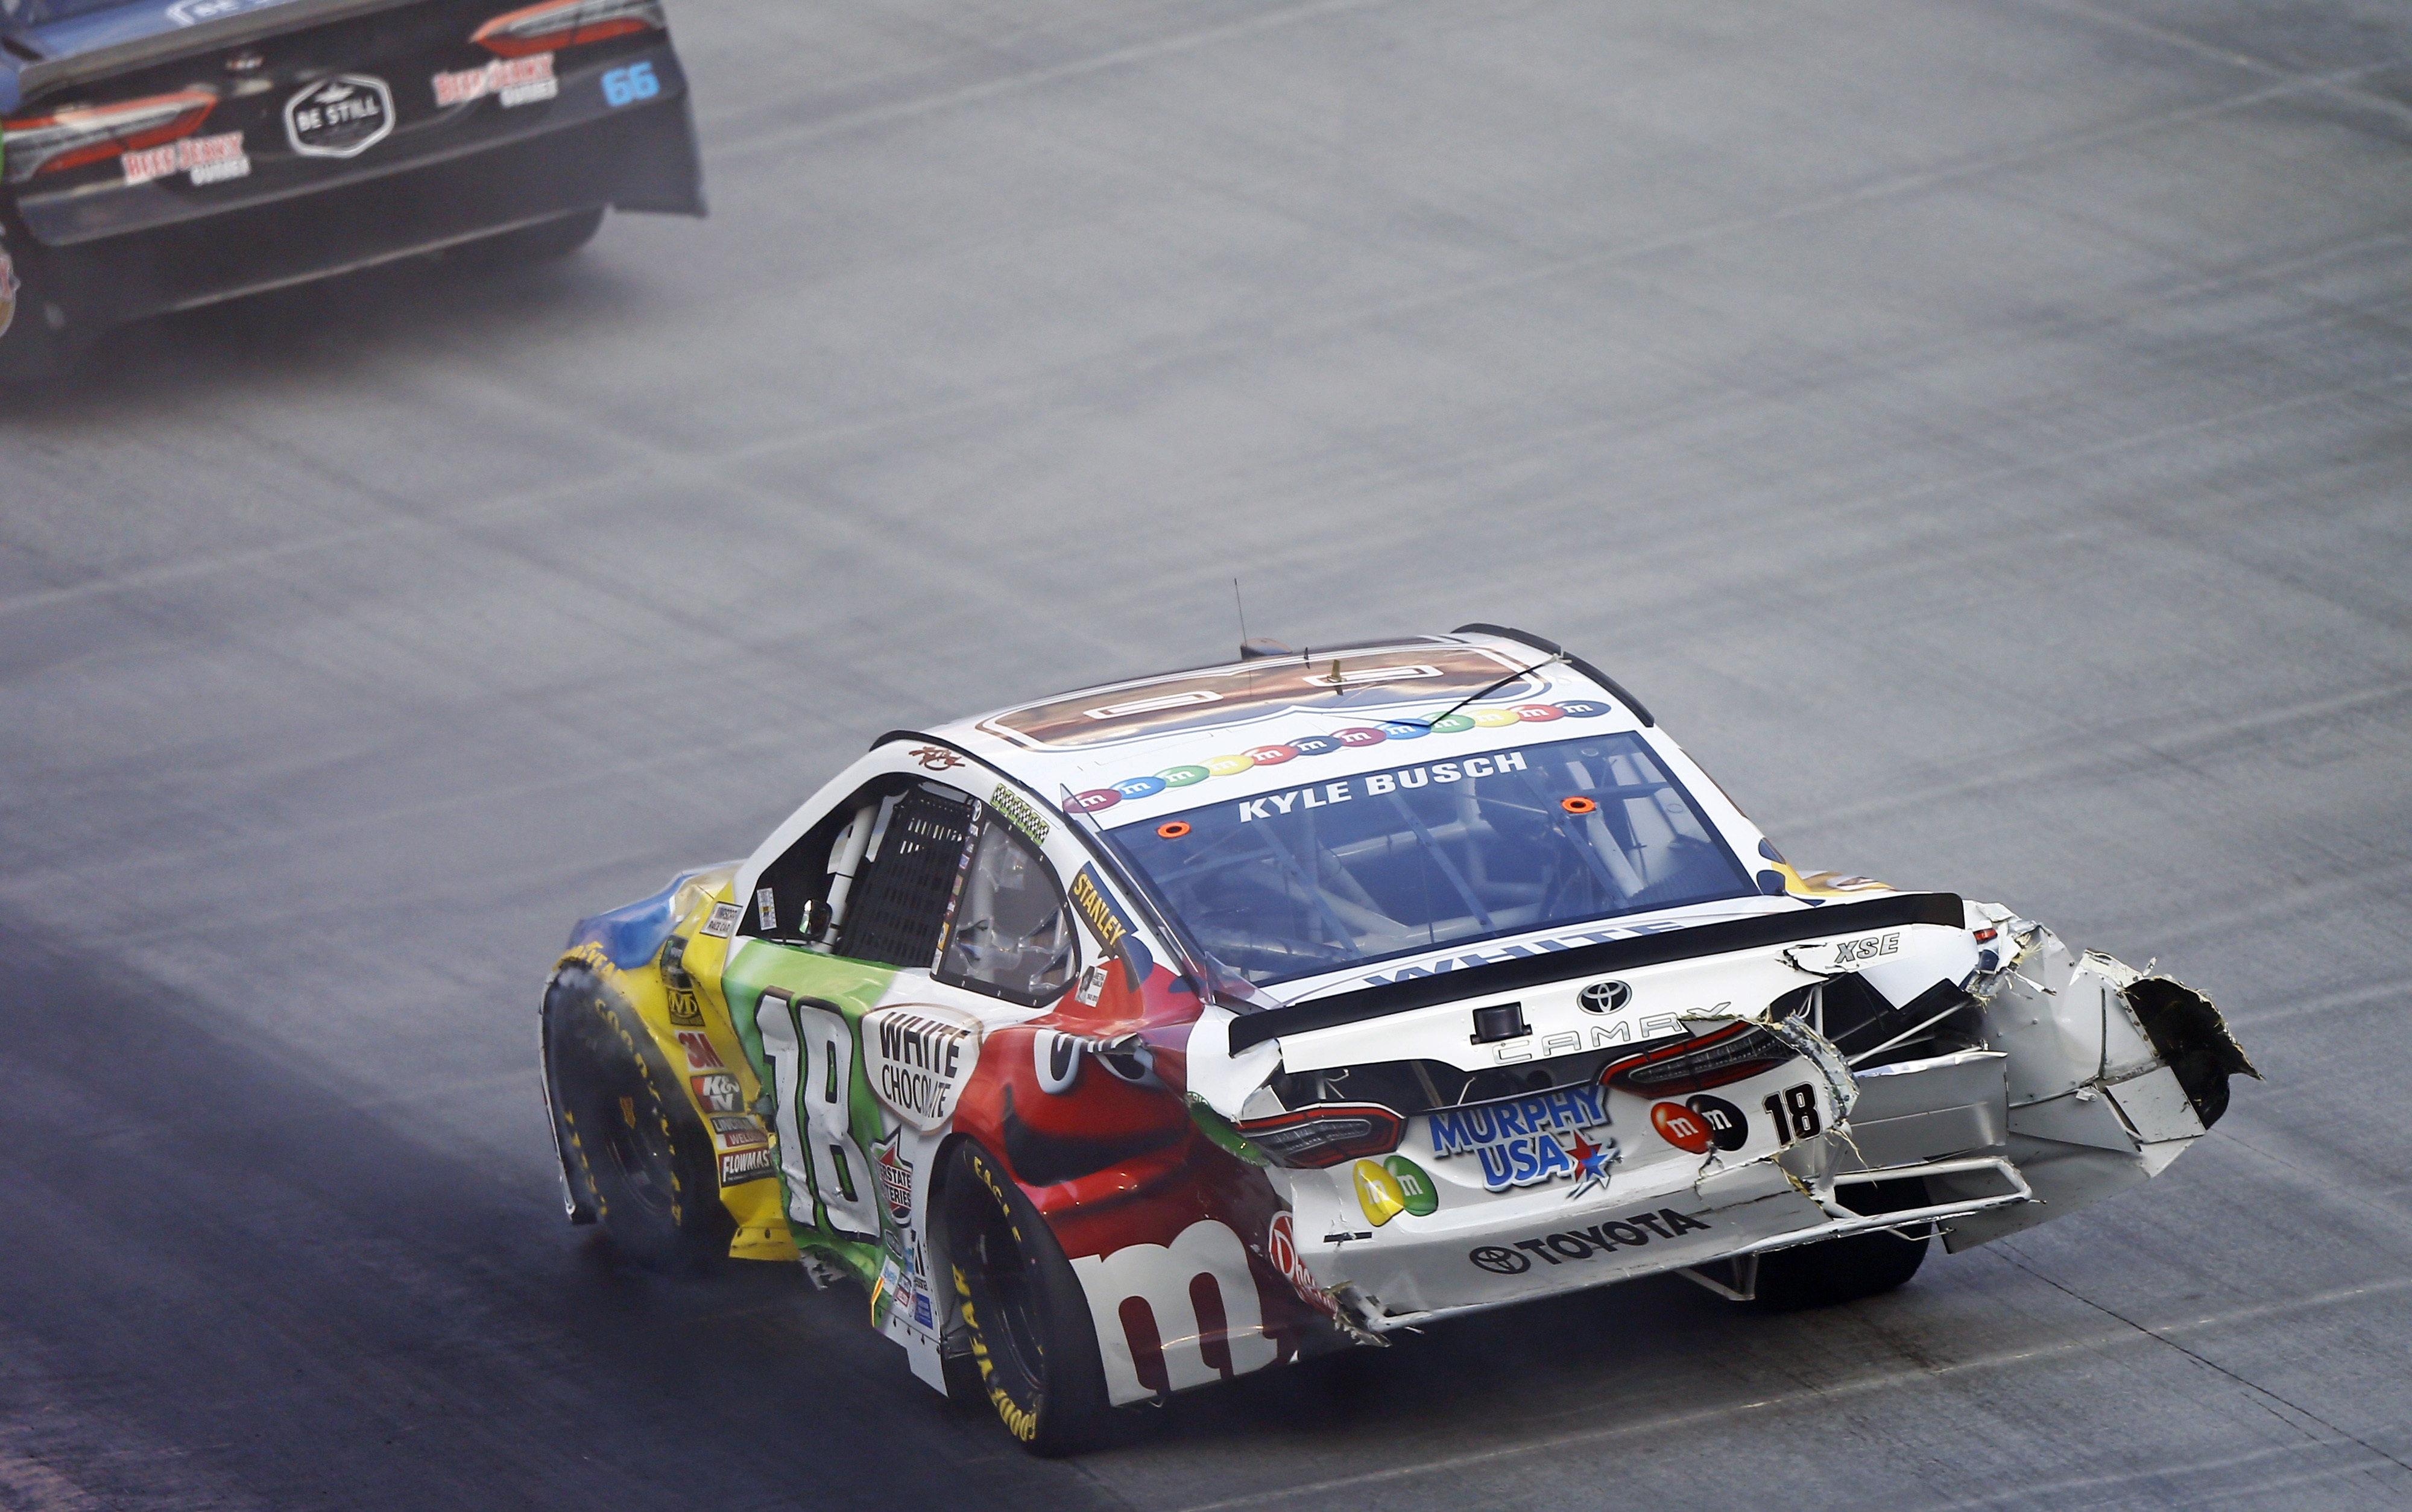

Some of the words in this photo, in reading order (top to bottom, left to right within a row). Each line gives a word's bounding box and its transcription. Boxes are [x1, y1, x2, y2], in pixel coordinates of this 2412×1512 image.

[601, 61, 660, 106] 66
[297, 108, 323, 132] BE
[326, 95, 381, 125] STILL
[1084, 793, 1107, 807] m
[1122, 782, 1151, 795] m
[1166, 769, 1195, 783] m
[1209, 759, 1238, 771] m
[1254, 749, 1283, 761] m
[1298, 740, 1327, 752] m
[1342, 731, 1371, 743] m
[1387, 723, 1416, 736] m
[1432, 717, 1460, 729] m
[1474, 712, 1503, 723] m
[1520, 707, 1549, 719] m
[1564, 703, 1593, 714] m
[1239, 781, 1352, 824] KYLE
[1364, 751, 1527, 797] BUSCH
[1074, 874, 1127, 945] STANLEY
[1834, 933, 1900, 963] XSE
[678, 1032, 725, 1069] 3M
[880, 1012, 971, 1079] WHITE
[754, 985, 881, 1246] 18
[1429, 1085, 1611, 1161] MURPHY
[1666, 1114, 1699, 1139] m
[1705, 1106, 1732, 1132] m
[1761, 1082, 1823, 1148] 18
[878, 1161, 911, 1189] ERSTATE
[1364, 1178, 1388, 1205] m
[1397, 1171, 1424, 1197] m
[1473, 1132, 1570, 1192] USA
[882, 1183, 911, 1208] TERIES
[1513, 1209, 1711, 1266] TOYOTA
[1069, 1219, 1278, 1407] m
